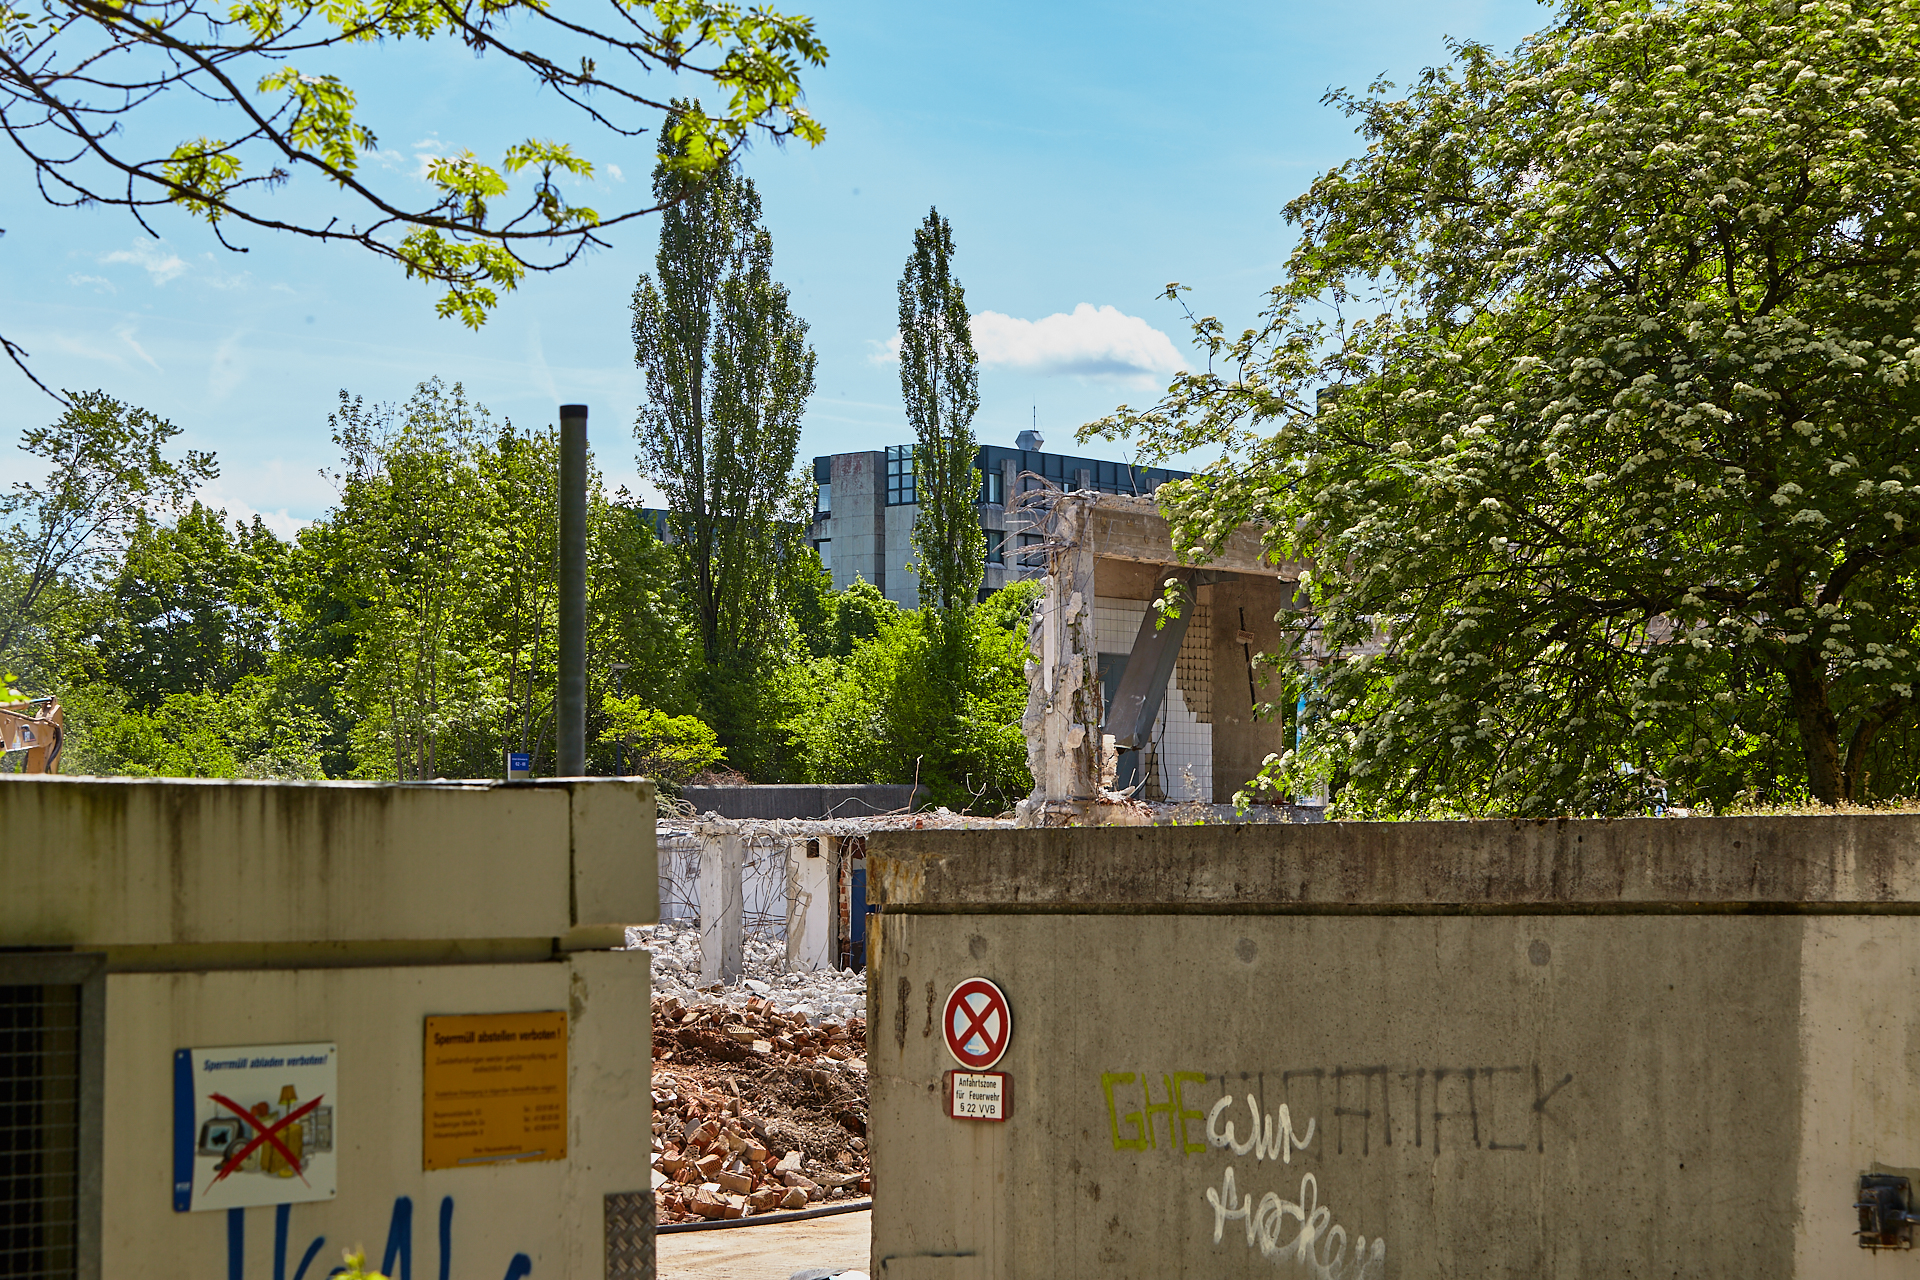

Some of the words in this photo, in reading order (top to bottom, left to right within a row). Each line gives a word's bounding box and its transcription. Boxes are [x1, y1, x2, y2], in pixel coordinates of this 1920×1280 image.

[433, 1030, 475, 1047] Sperrmüll
[477, 1028, 516, 1044] abstellen
[203, 1058, 249, 1073] Sperrmüll
[250, 1056, 284, 1070] abladen
[287, 1054, 328, 1067] verboten!
[958, 1077, 997, 1089] Anfahrtszone
[956, 1090, 965, 1100] für
[969, 1090, 1000, 1102] Feuerwehr
[960, 1102, 965, 1112] §
[967, 1103, 976, 1113] 22
[979, 1104, 996, 1114] VVB
